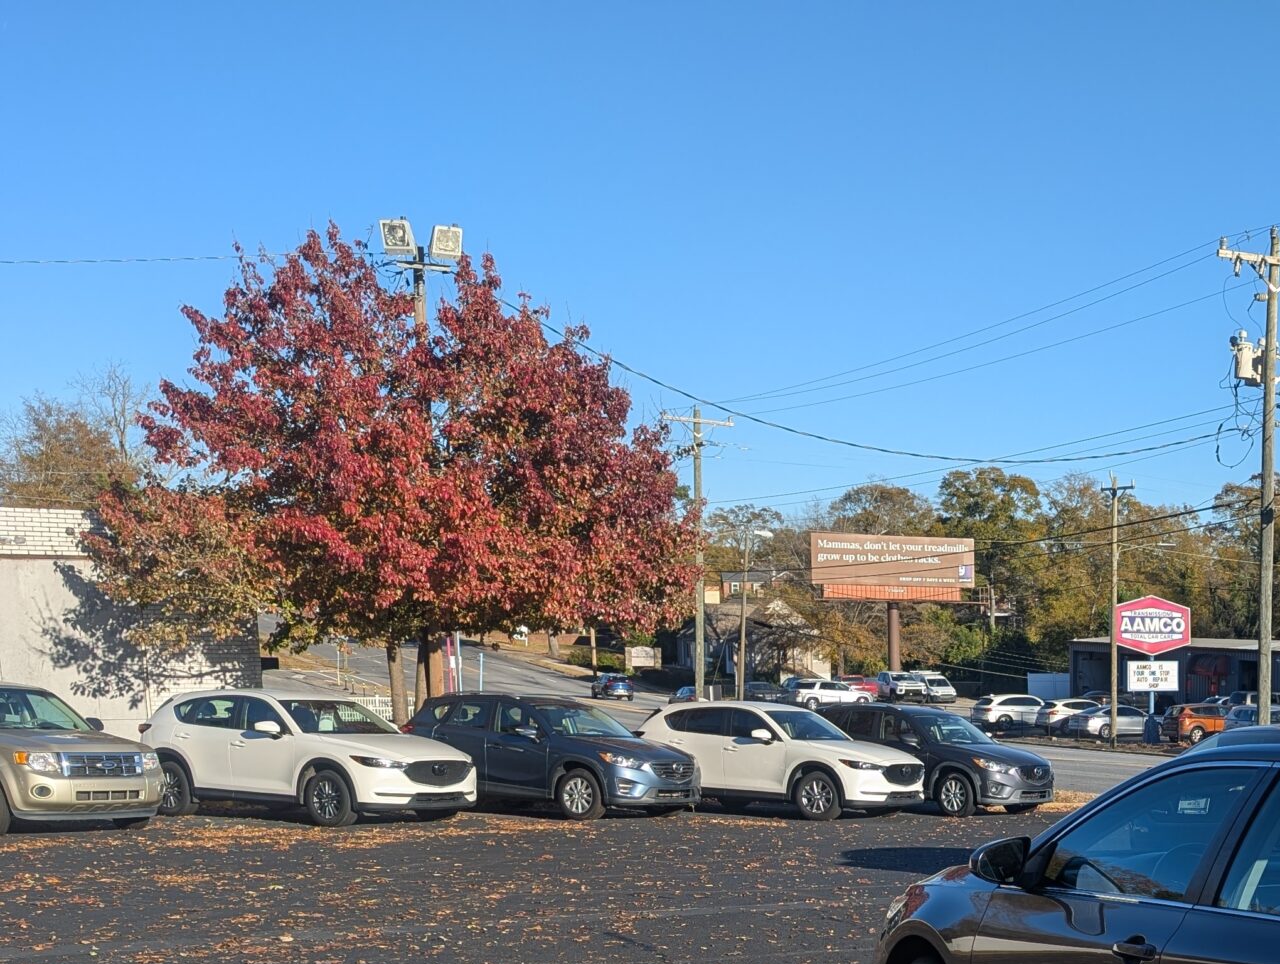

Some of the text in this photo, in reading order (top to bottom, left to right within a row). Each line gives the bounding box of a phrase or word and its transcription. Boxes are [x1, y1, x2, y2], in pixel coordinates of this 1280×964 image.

[817, 539, 969, 552] Mammas, don't let your treadmills
[817, 553, 841, 562] grow
[842, 554, 855, 563] up
[868, 553, 879, 562] be
[881, 553, 913, 562] clothes
[1120, 616, 1185, 633] AAMCO
